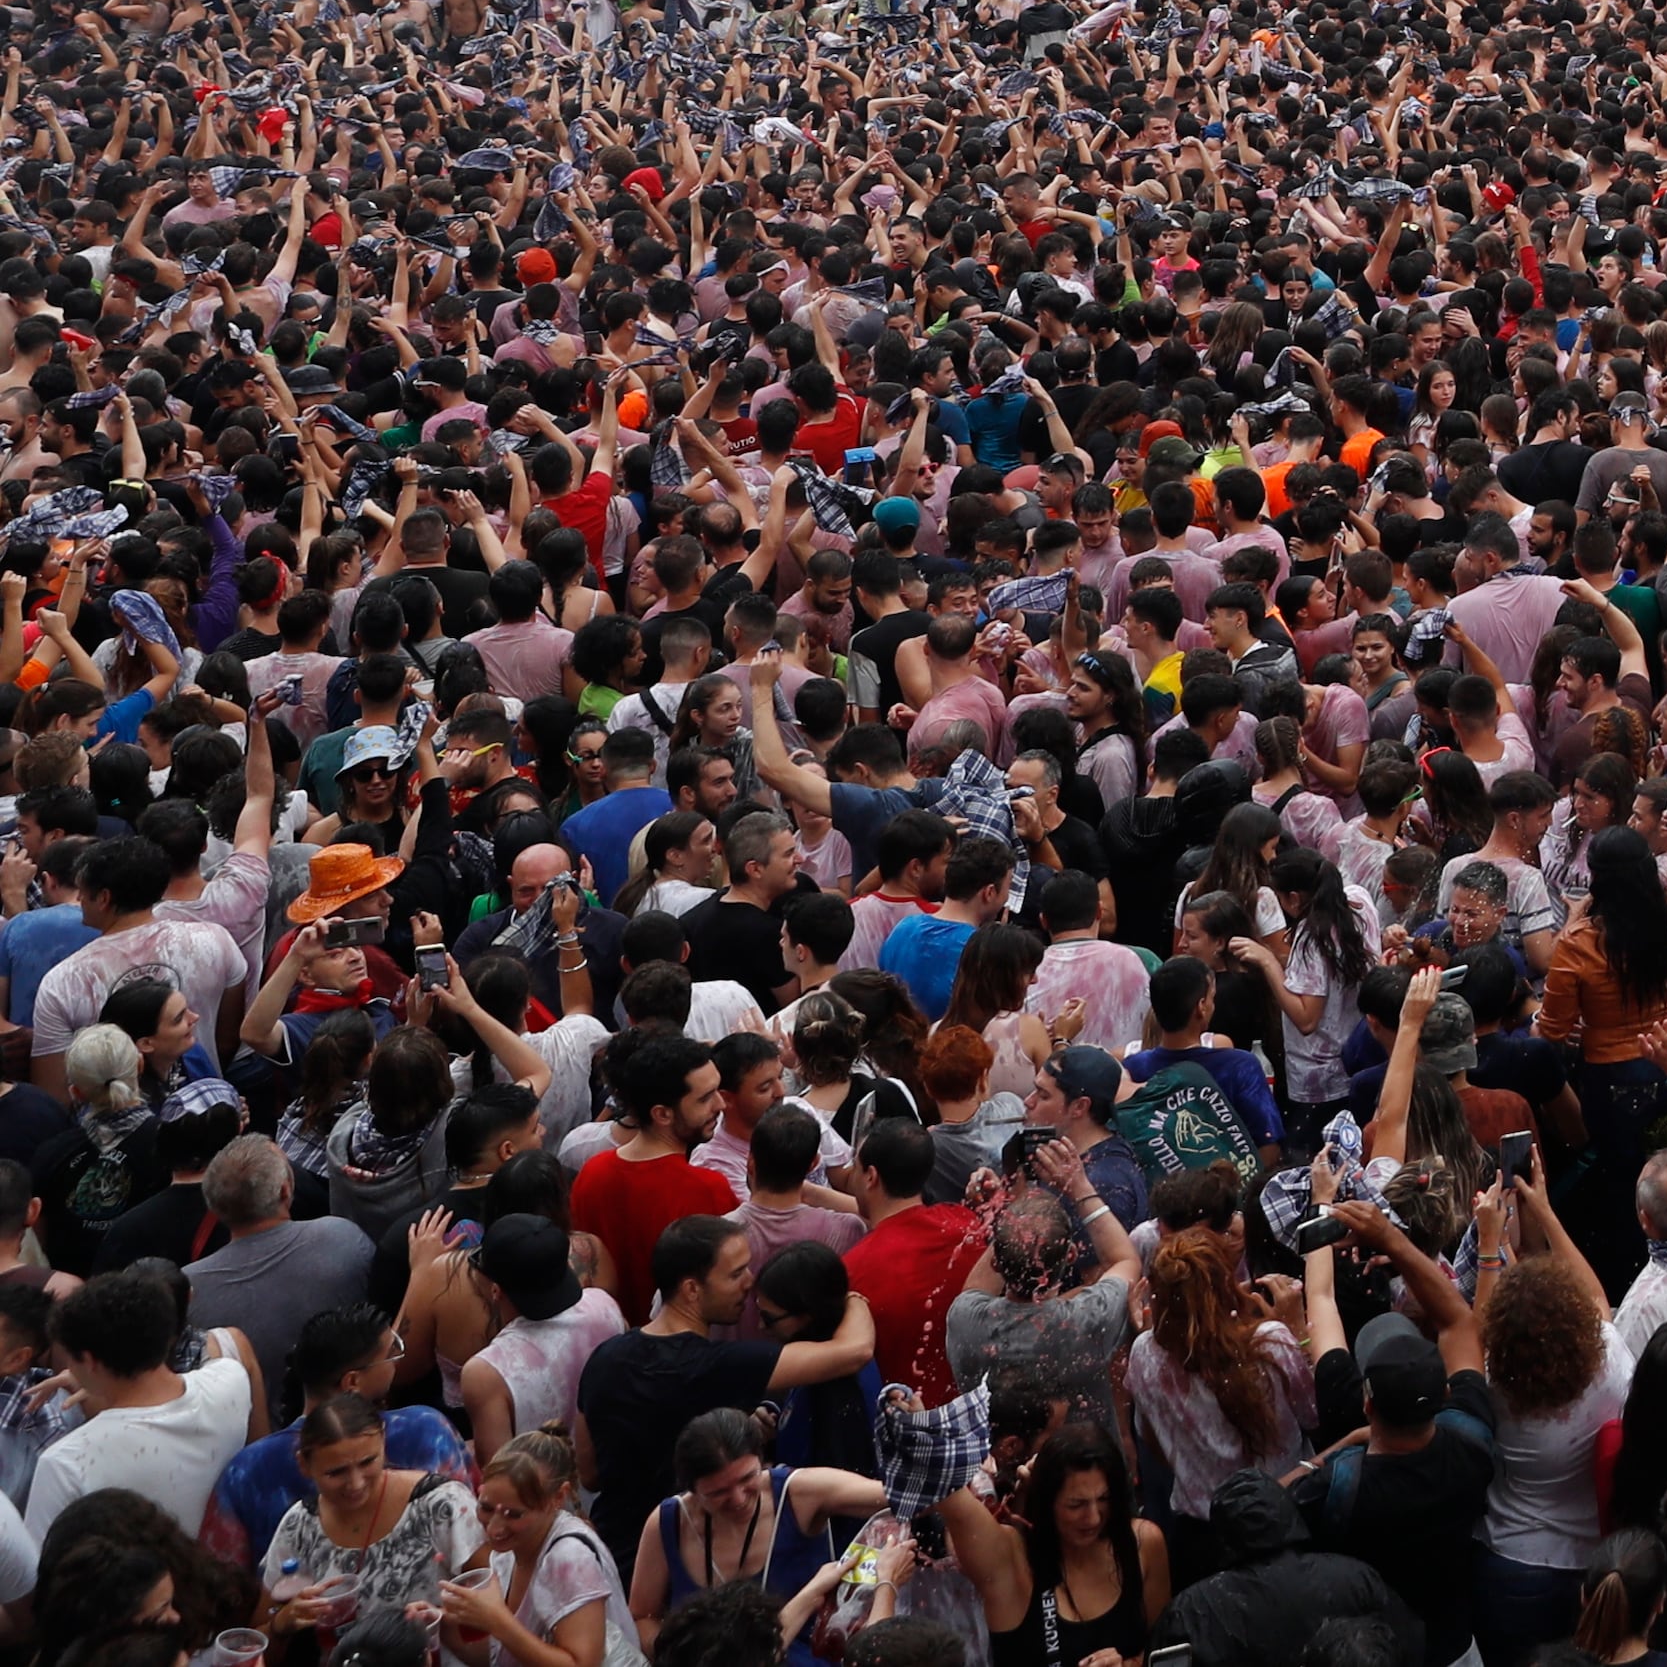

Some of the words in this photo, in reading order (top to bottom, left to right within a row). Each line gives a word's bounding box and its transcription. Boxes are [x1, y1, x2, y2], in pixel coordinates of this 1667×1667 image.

[730, 435, 756, 450] UTIO
[1148, 1109, 1169, 1131] MA
[1166, 1086, 1196, 1111] CHE
[1199, 1086, 1233, 1124] CAZZO
[1227, 1123, 1251, 1155] FAI?
